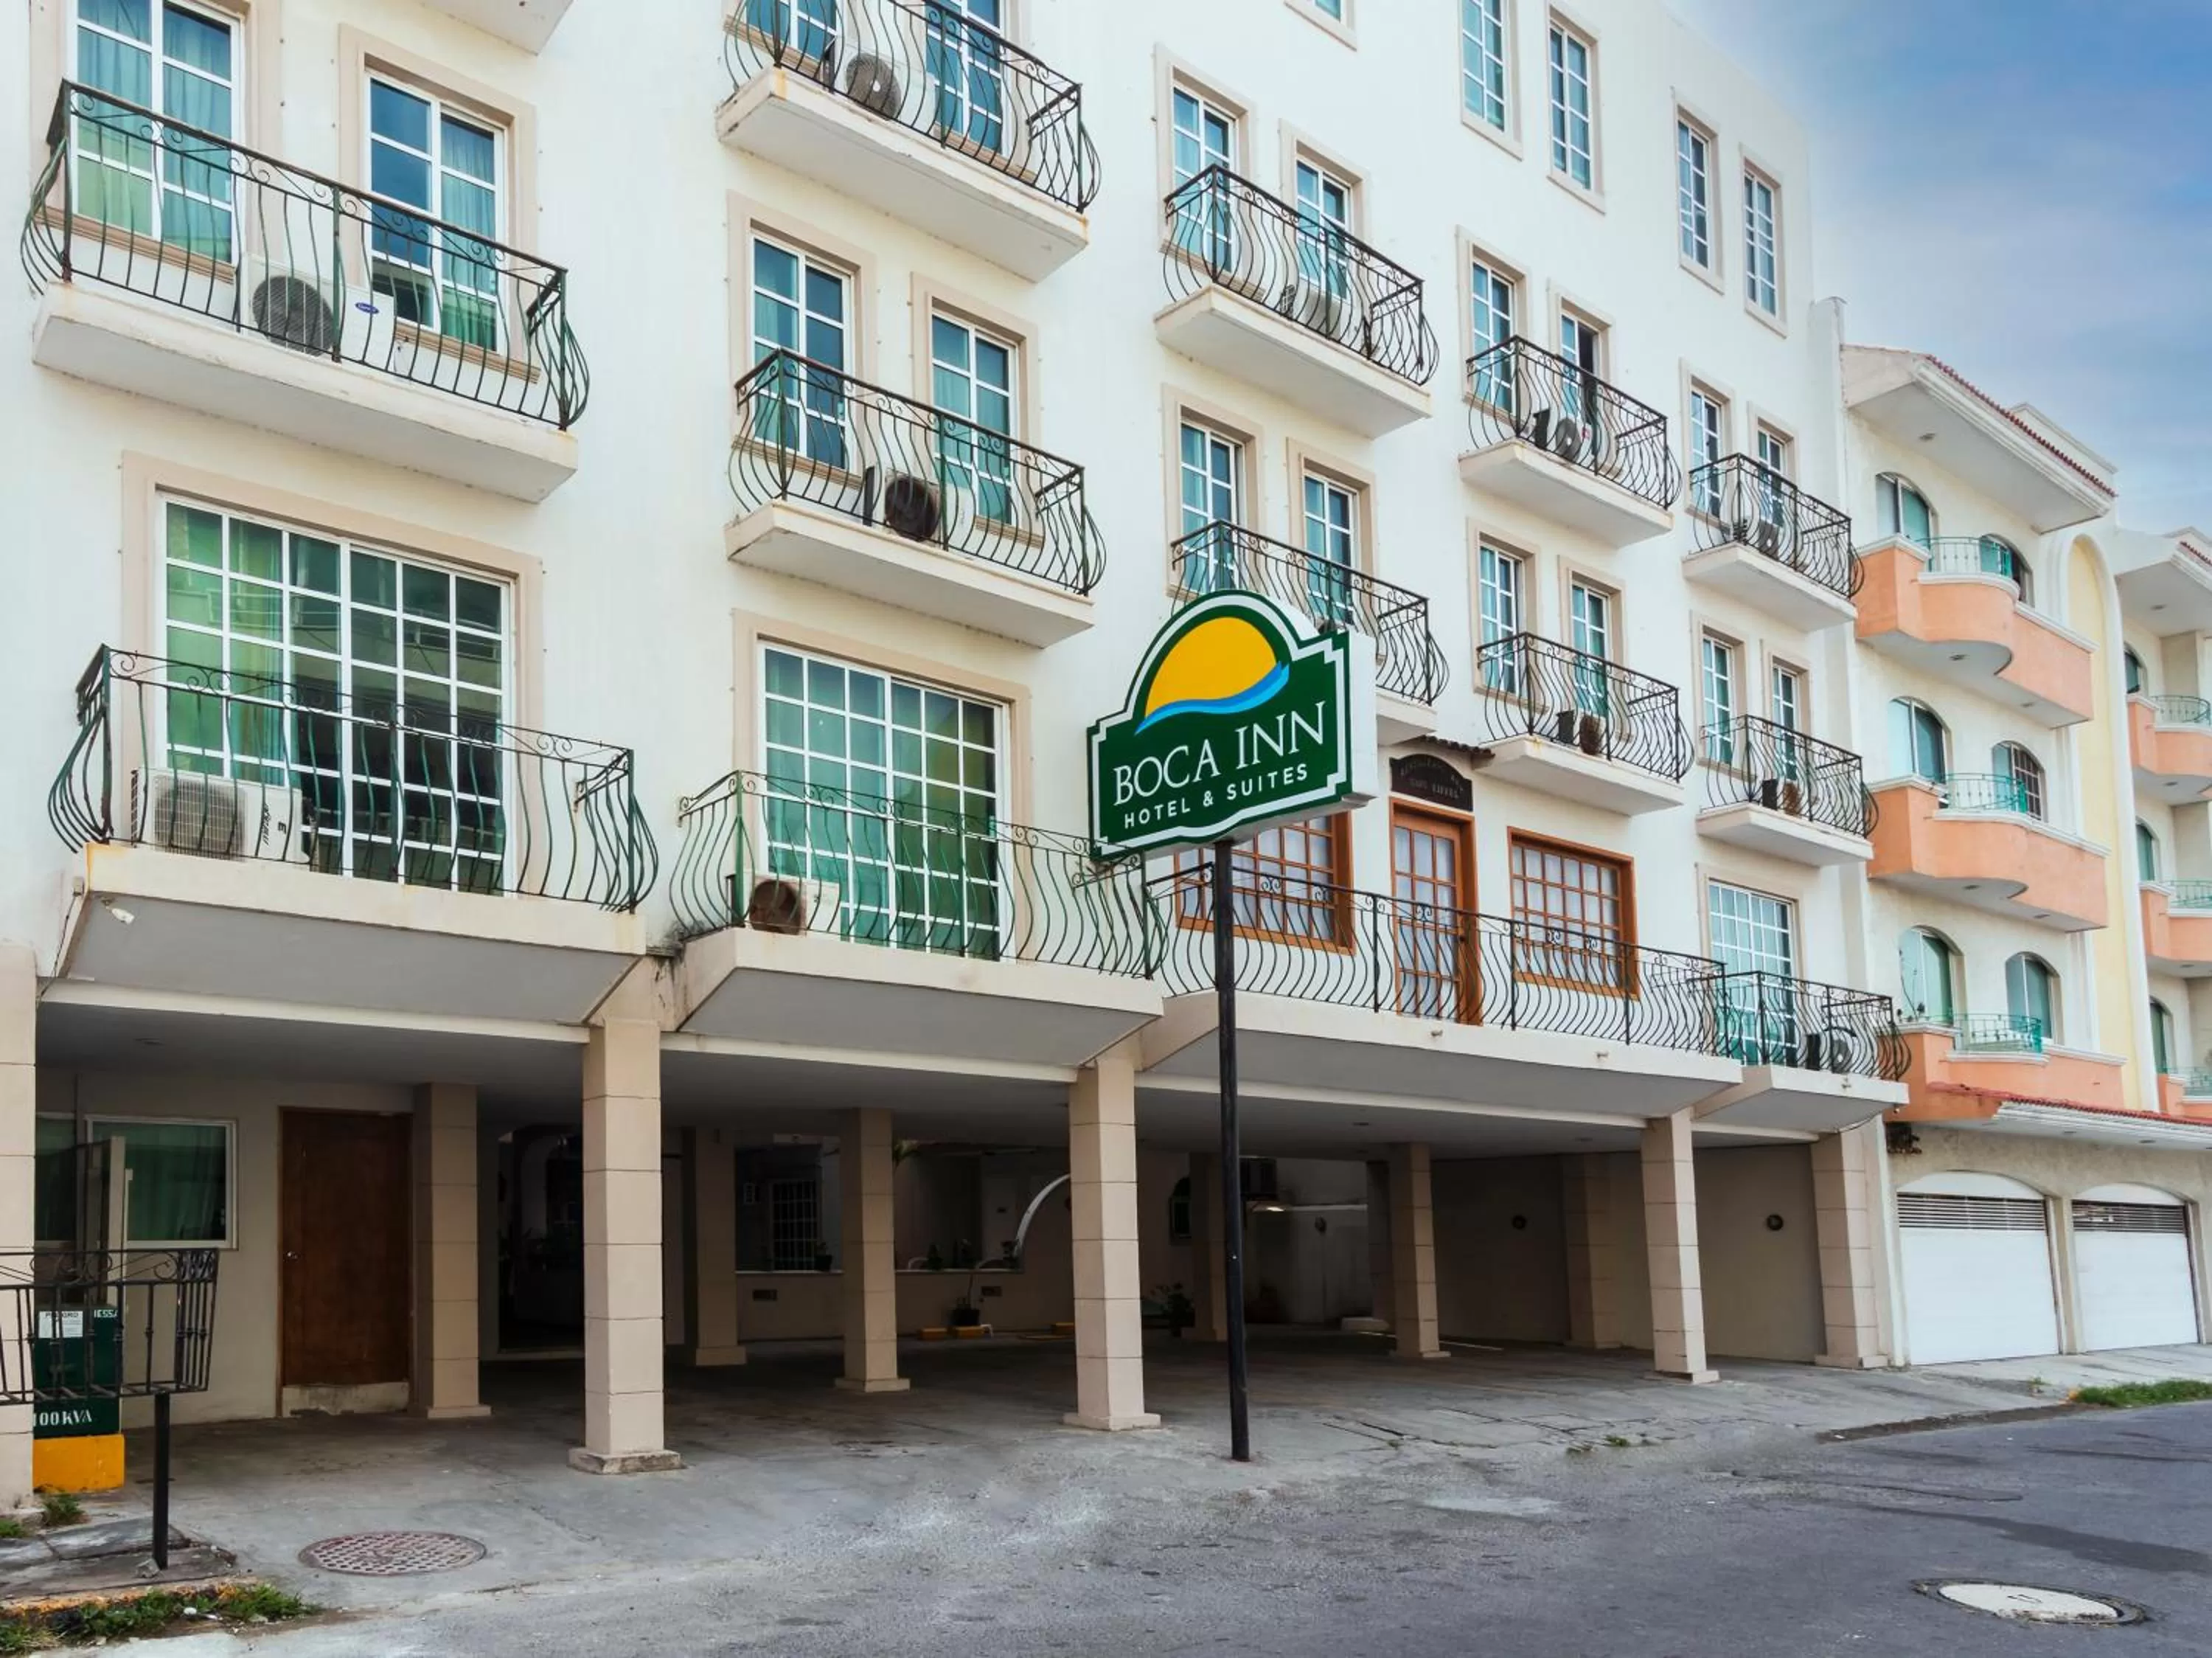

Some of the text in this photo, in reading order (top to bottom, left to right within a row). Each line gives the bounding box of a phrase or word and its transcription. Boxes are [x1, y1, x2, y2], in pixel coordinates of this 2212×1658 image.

[1113, 701, 1326, 806] BOCA INN
[1124, 763, 1308, 829] HOTEL & SUITES
